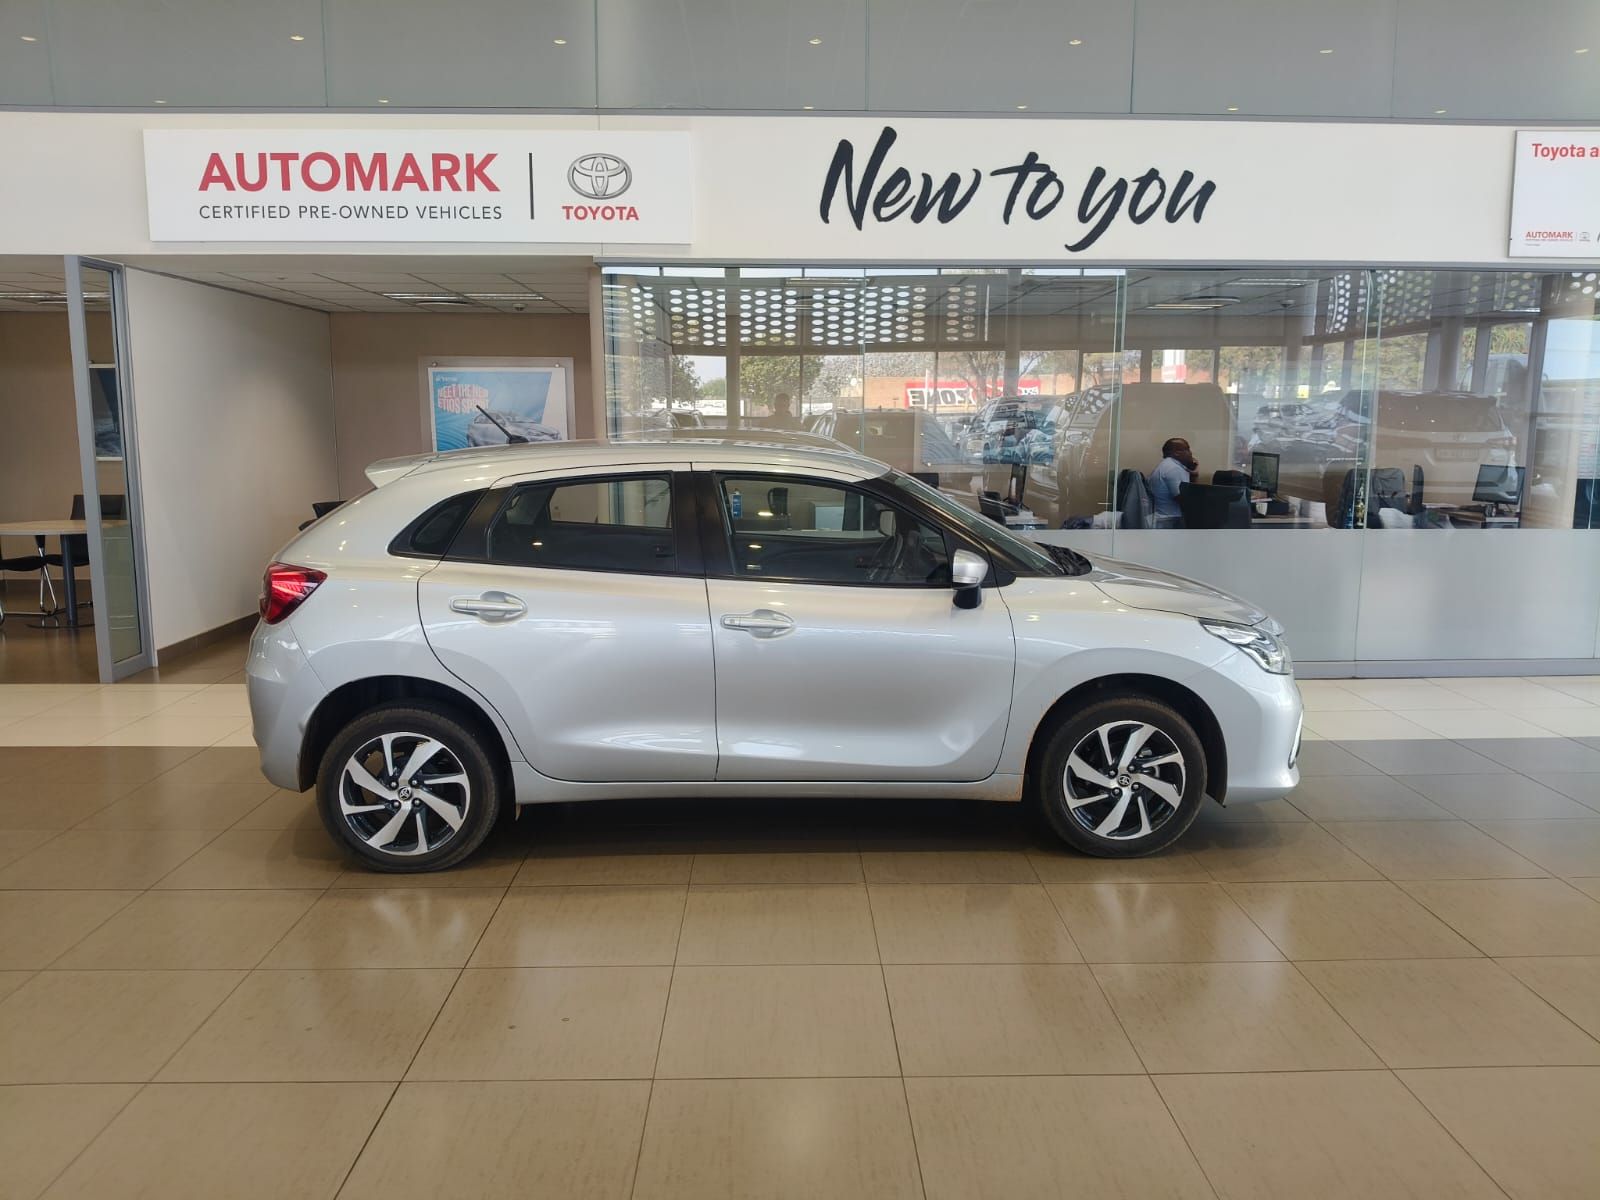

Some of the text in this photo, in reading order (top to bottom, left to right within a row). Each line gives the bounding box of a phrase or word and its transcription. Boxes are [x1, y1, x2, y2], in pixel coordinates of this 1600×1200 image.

[1532, 143, 1586, 161] Toyota
[199, 152, 500, 192] AUTOMARK
[820, 126, 1217, 252] New to you
[199, 205, 502, 219] CERTIFIED PRE-OWNED VEHICLES
[562, 205, 640, 221] TOYOTA
[1526, 231, 1573, 239] AUTOMARK
